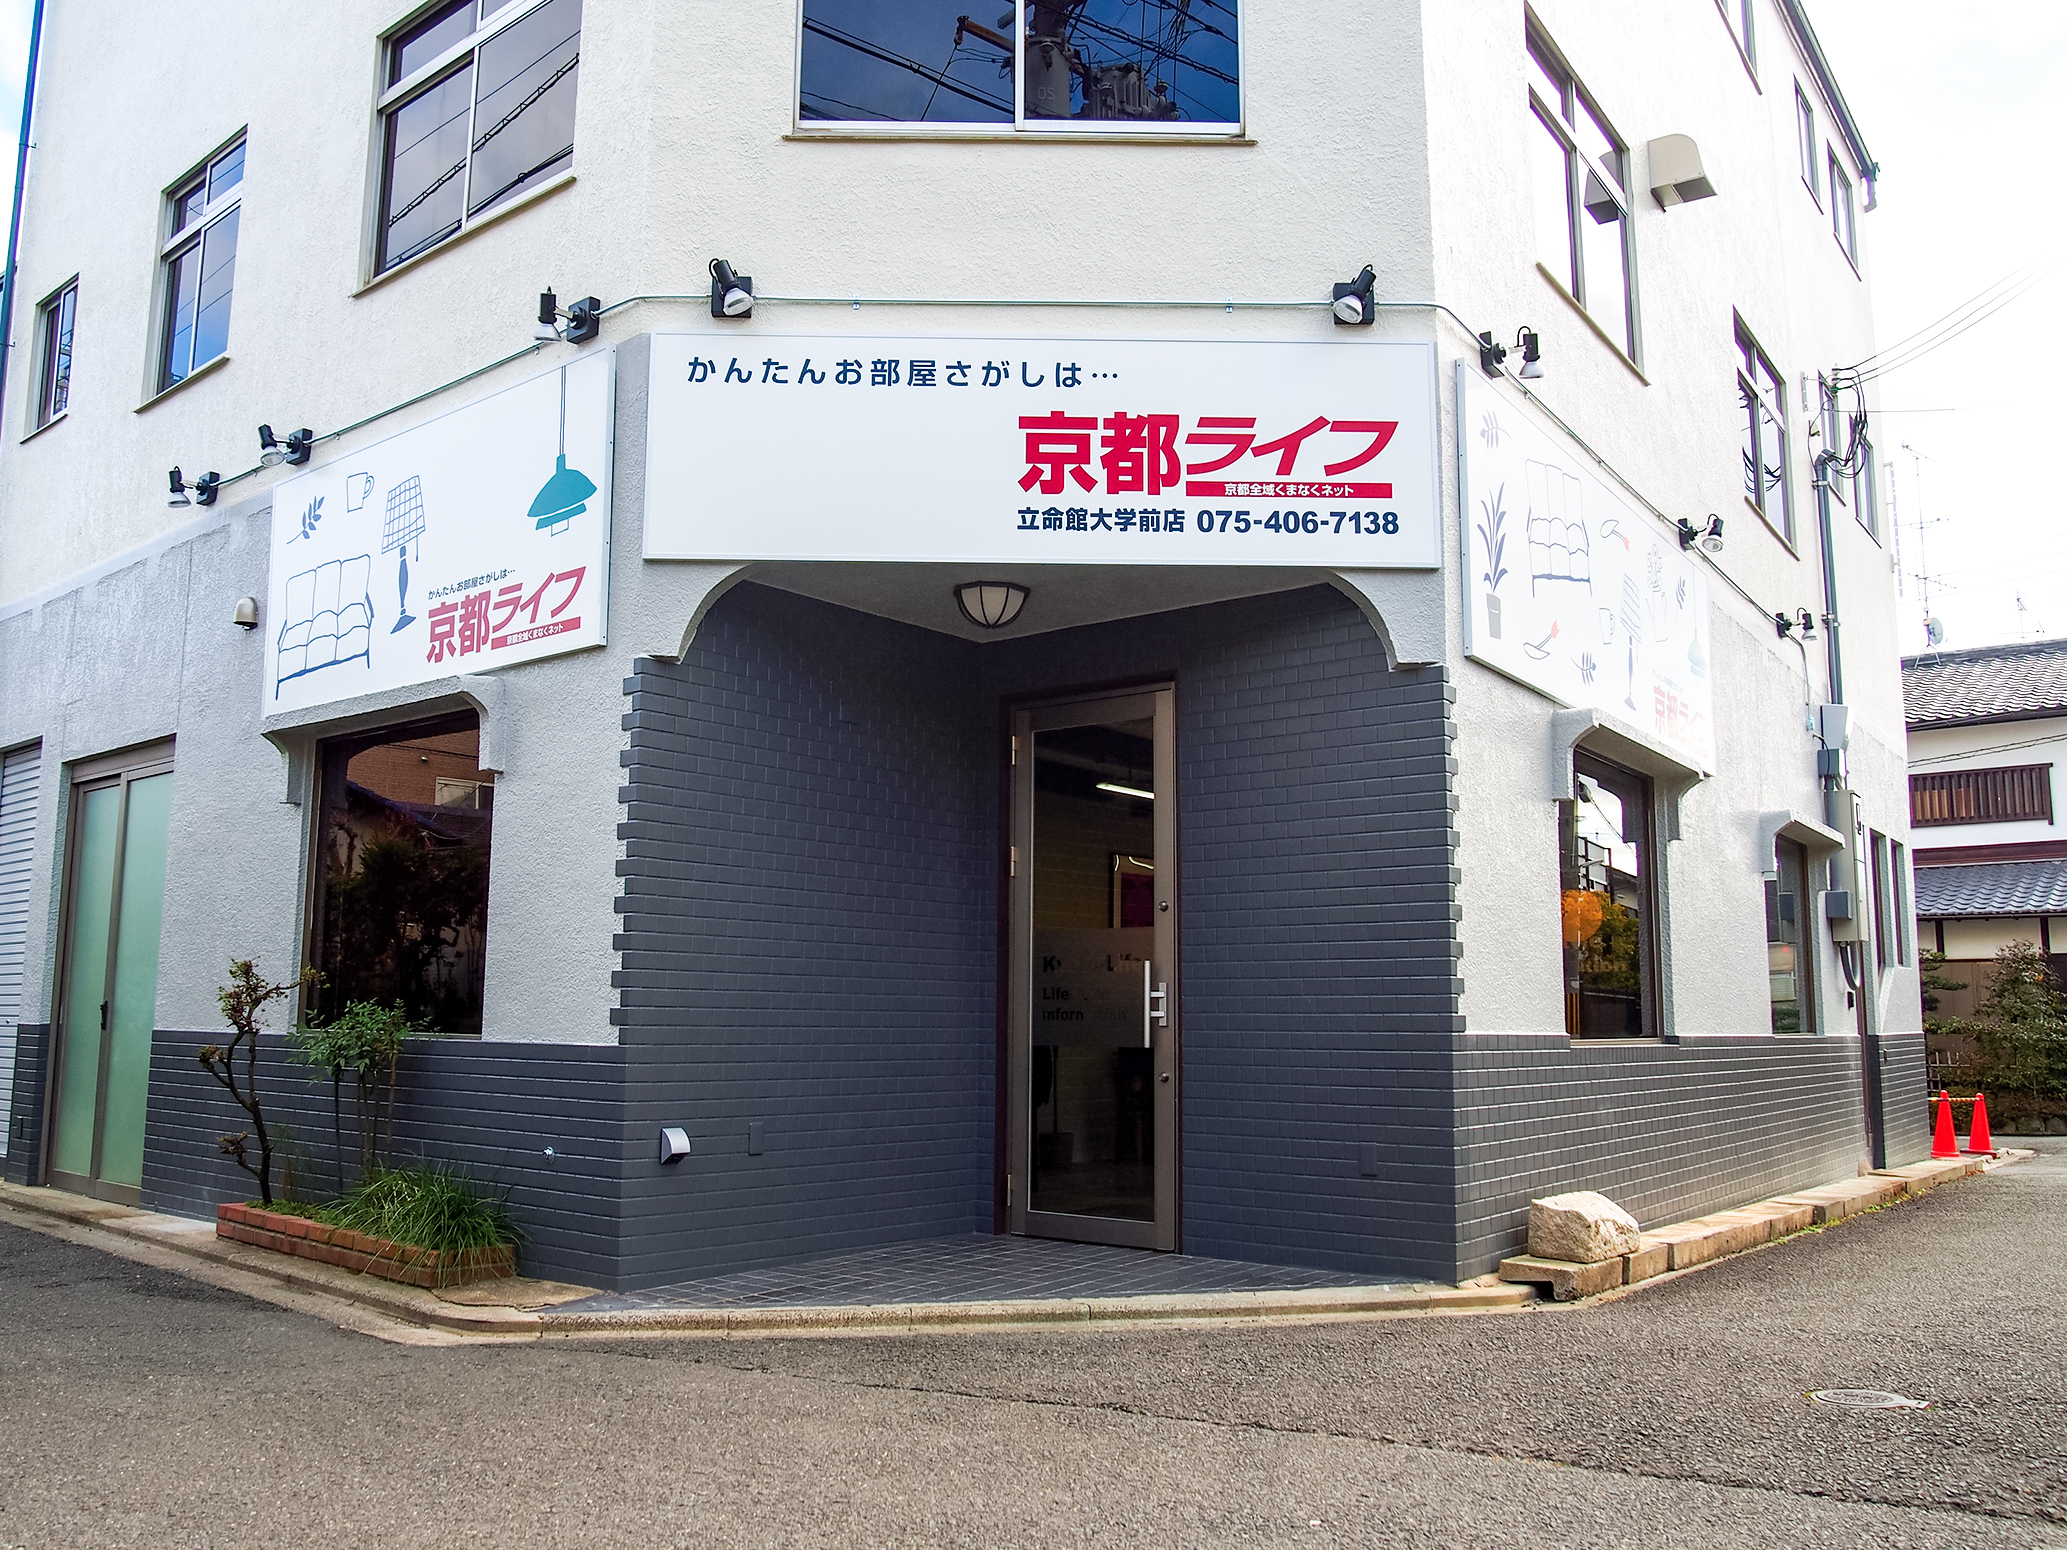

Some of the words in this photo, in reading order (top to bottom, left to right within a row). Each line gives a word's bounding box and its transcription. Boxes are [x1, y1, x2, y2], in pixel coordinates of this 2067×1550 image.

[1018, 411, 1399, 497] 京都ライフ
[1224, 482, 1354, 497] 京都全域くまなくネット
[1017, 507, 1186, 533] 立命館大学前店
[1196, 509, 1400, 535] 075-406-7138
[426, 566, 587, 663] 京都ライフ
[1042, 986, 1070, 1001] Life
